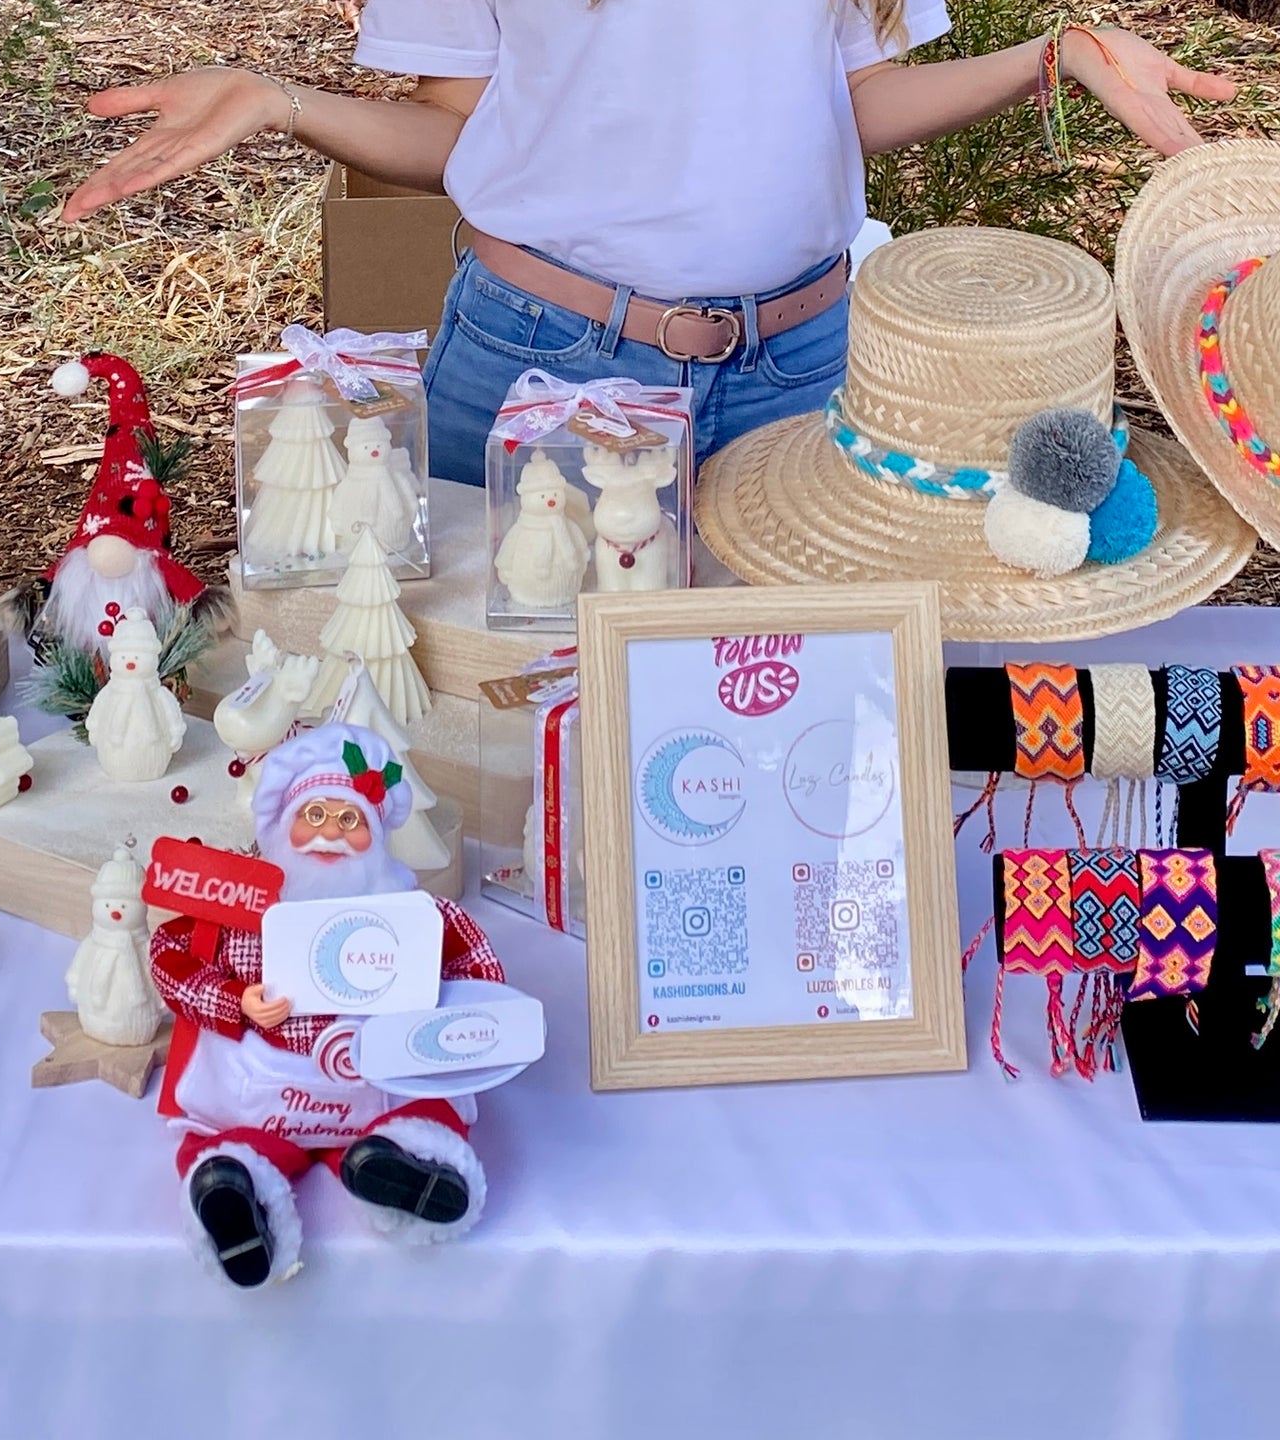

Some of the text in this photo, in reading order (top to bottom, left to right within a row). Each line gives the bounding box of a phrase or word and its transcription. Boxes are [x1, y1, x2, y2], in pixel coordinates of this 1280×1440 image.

[733, 666, 781, 710] US
[682, 777, 741, 794] KASHI
[153, 862, 268, 914] WELCOME
[346, 952, 395, 964] KASHI
[653, 981, 746, 999] KASHIDESIGNS.AU
[445, 1028, 496, 1043] KASHI
[280, 1087, 352, 1123] Merry
